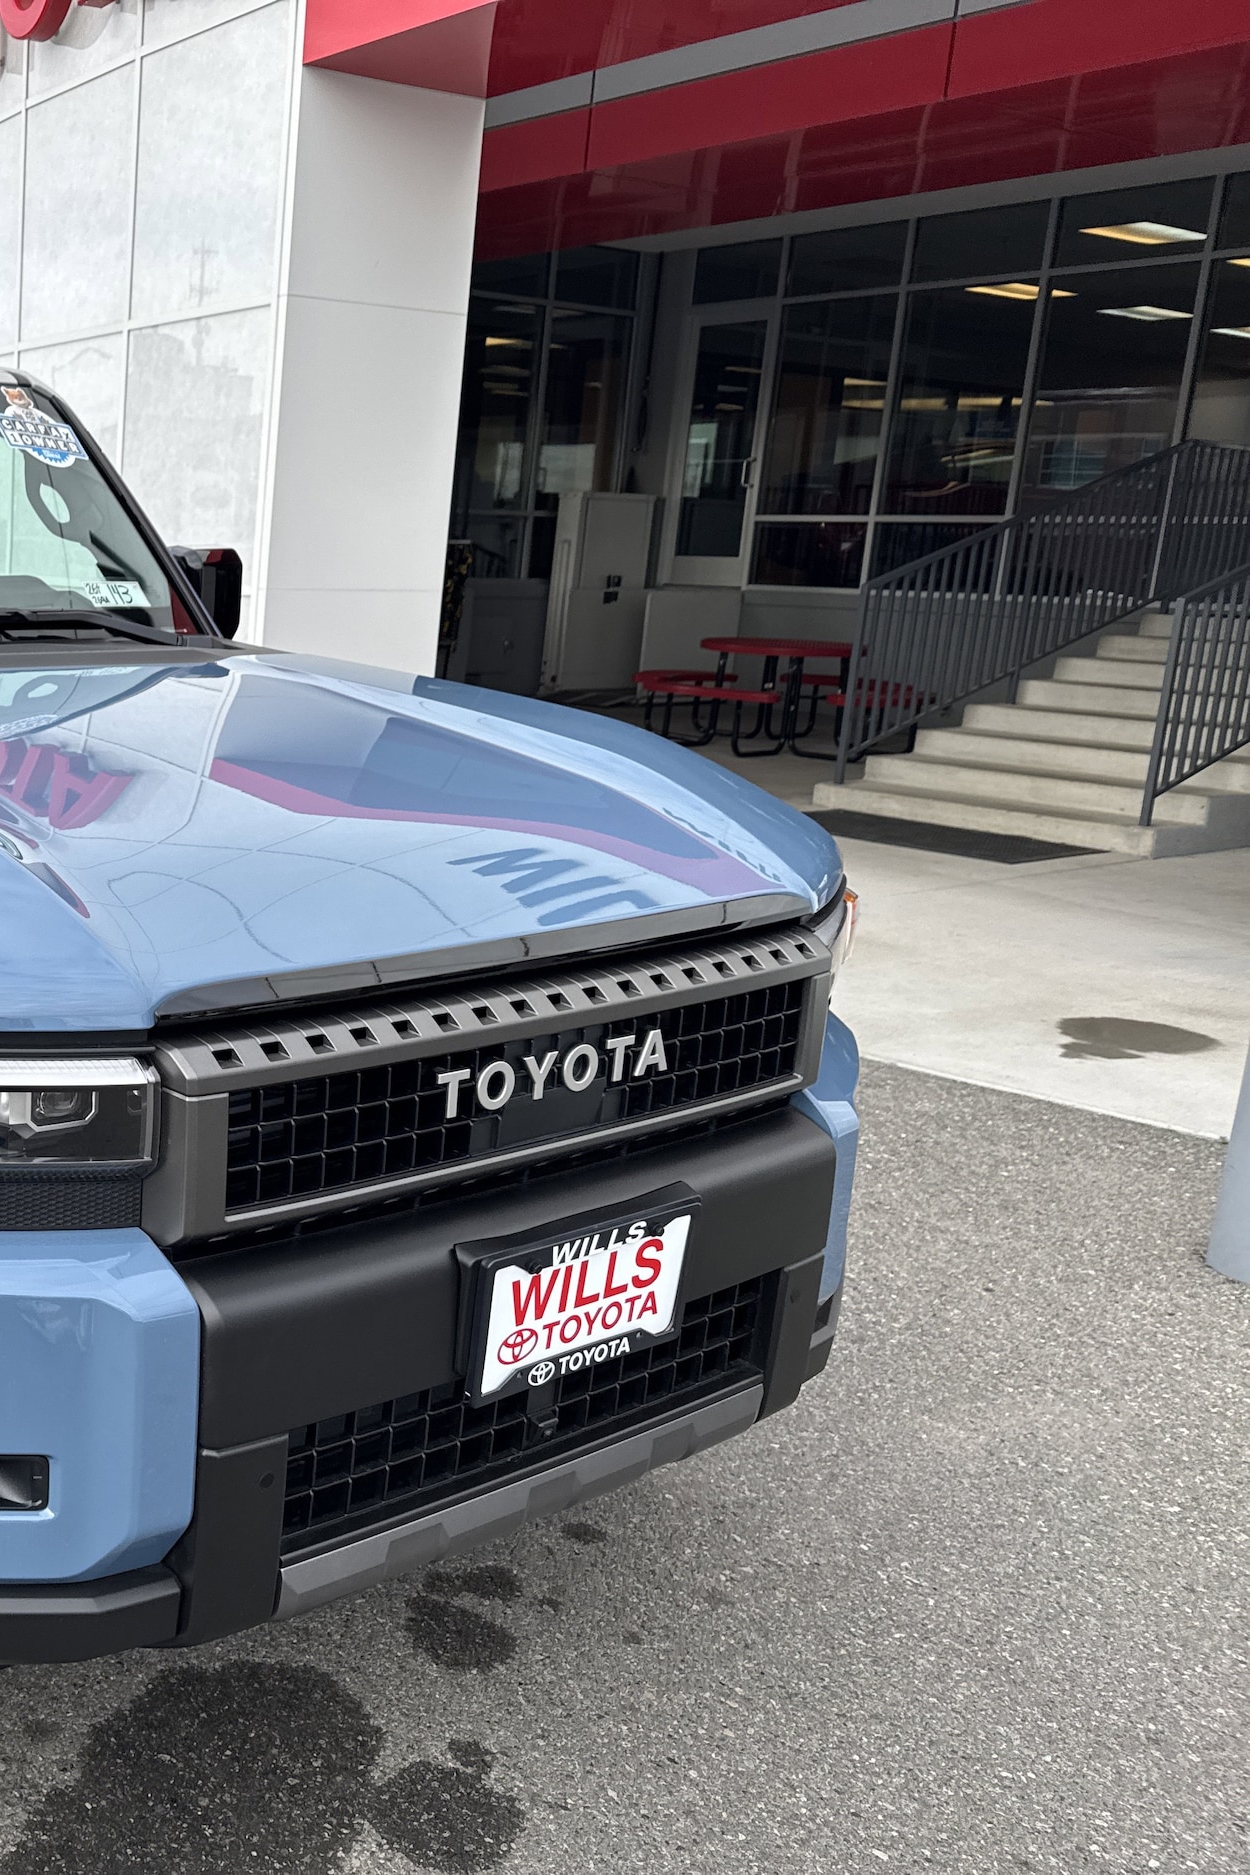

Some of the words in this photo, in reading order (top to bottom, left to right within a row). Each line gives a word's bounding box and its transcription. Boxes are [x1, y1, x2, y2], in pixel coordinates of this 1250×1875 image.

[1, 418, 73, 442] CARFAX
[437, 1029, 668, 1119] TOYOTA
[552, 1221, 648, 1267] WILLS
[512, 1238, 664, 1327] WILLS
[542, 1291, 658, 1350] TOYOTA
[558, 1336, 631, 1375] TOYOTA
